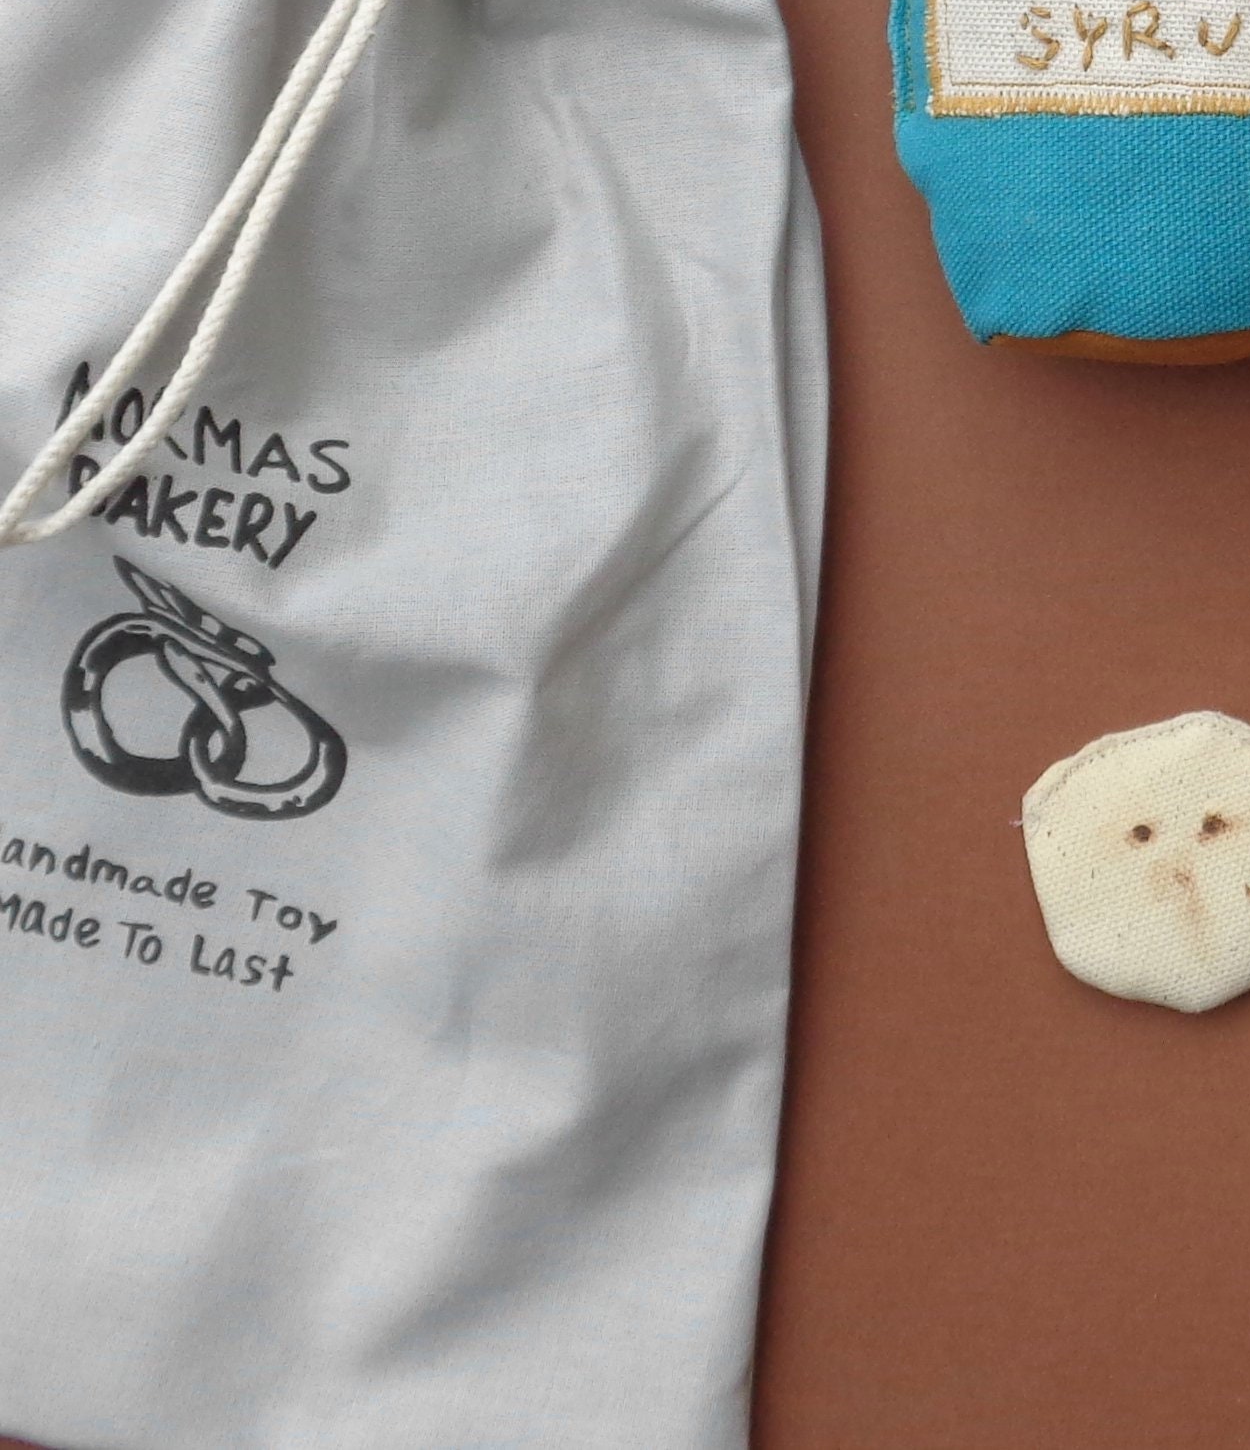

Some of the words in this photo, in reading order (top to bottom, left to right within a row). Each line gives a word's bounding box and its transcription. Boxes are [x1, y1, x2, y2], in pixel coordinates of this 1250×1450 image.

[0, 828, 218, 909] andmade
[246, 888, 338, 945] Toy
[117, 920, 164, 965] To
[190, 933, 295, 993] Last
